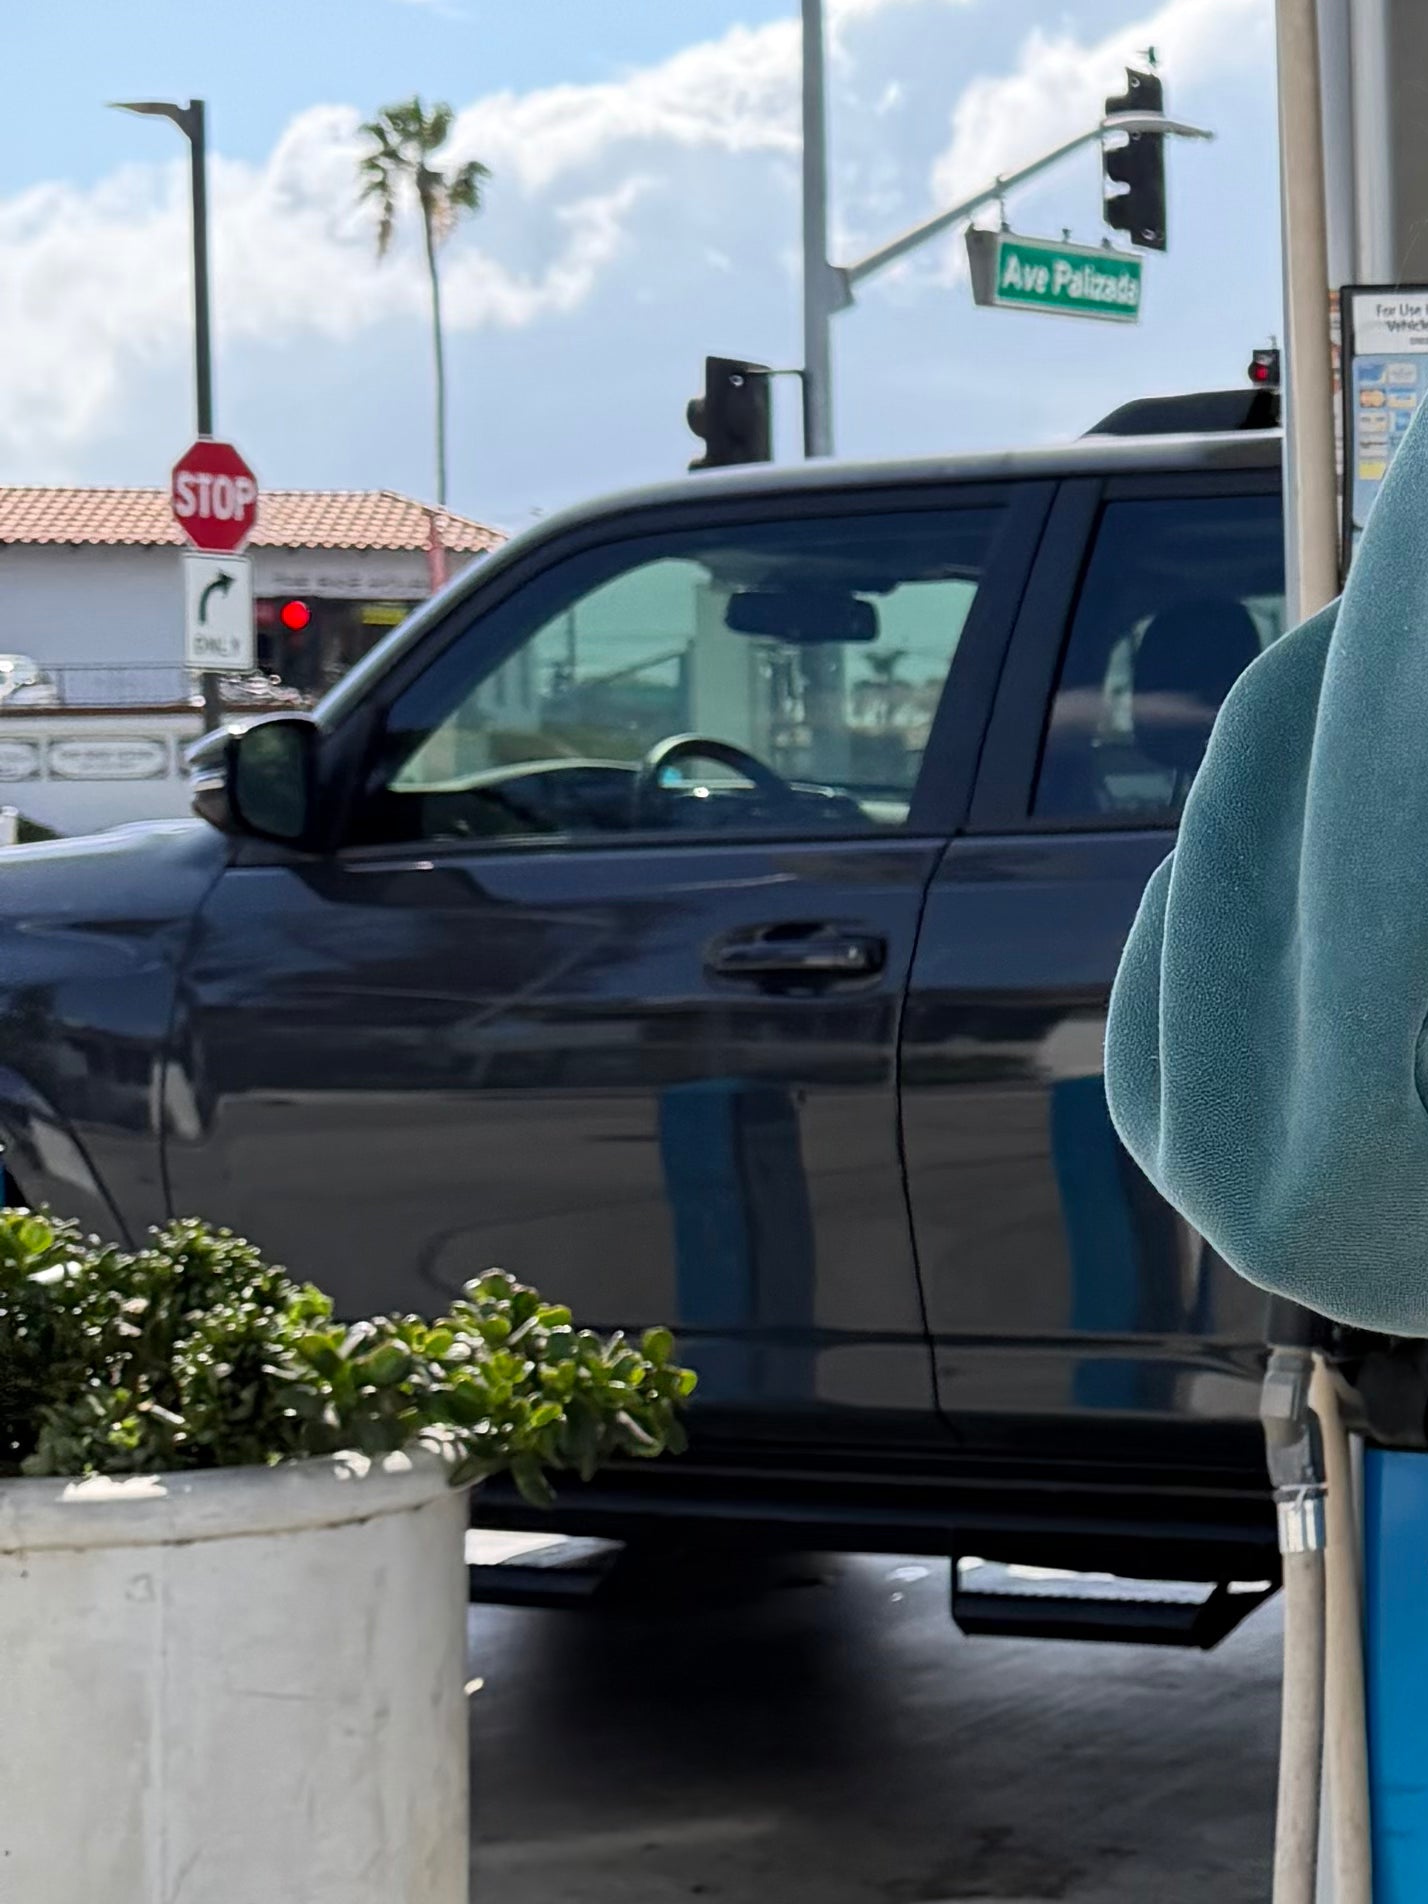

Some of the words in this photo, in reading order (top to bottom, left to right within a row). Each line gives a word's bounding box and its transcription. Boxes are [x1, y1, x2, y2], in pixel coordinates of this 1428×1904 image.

[1002, 254, 1048, 294] Ave
[1052, 258, 1139, 306] Palizada
[175, 469, 255, 521] STOP
